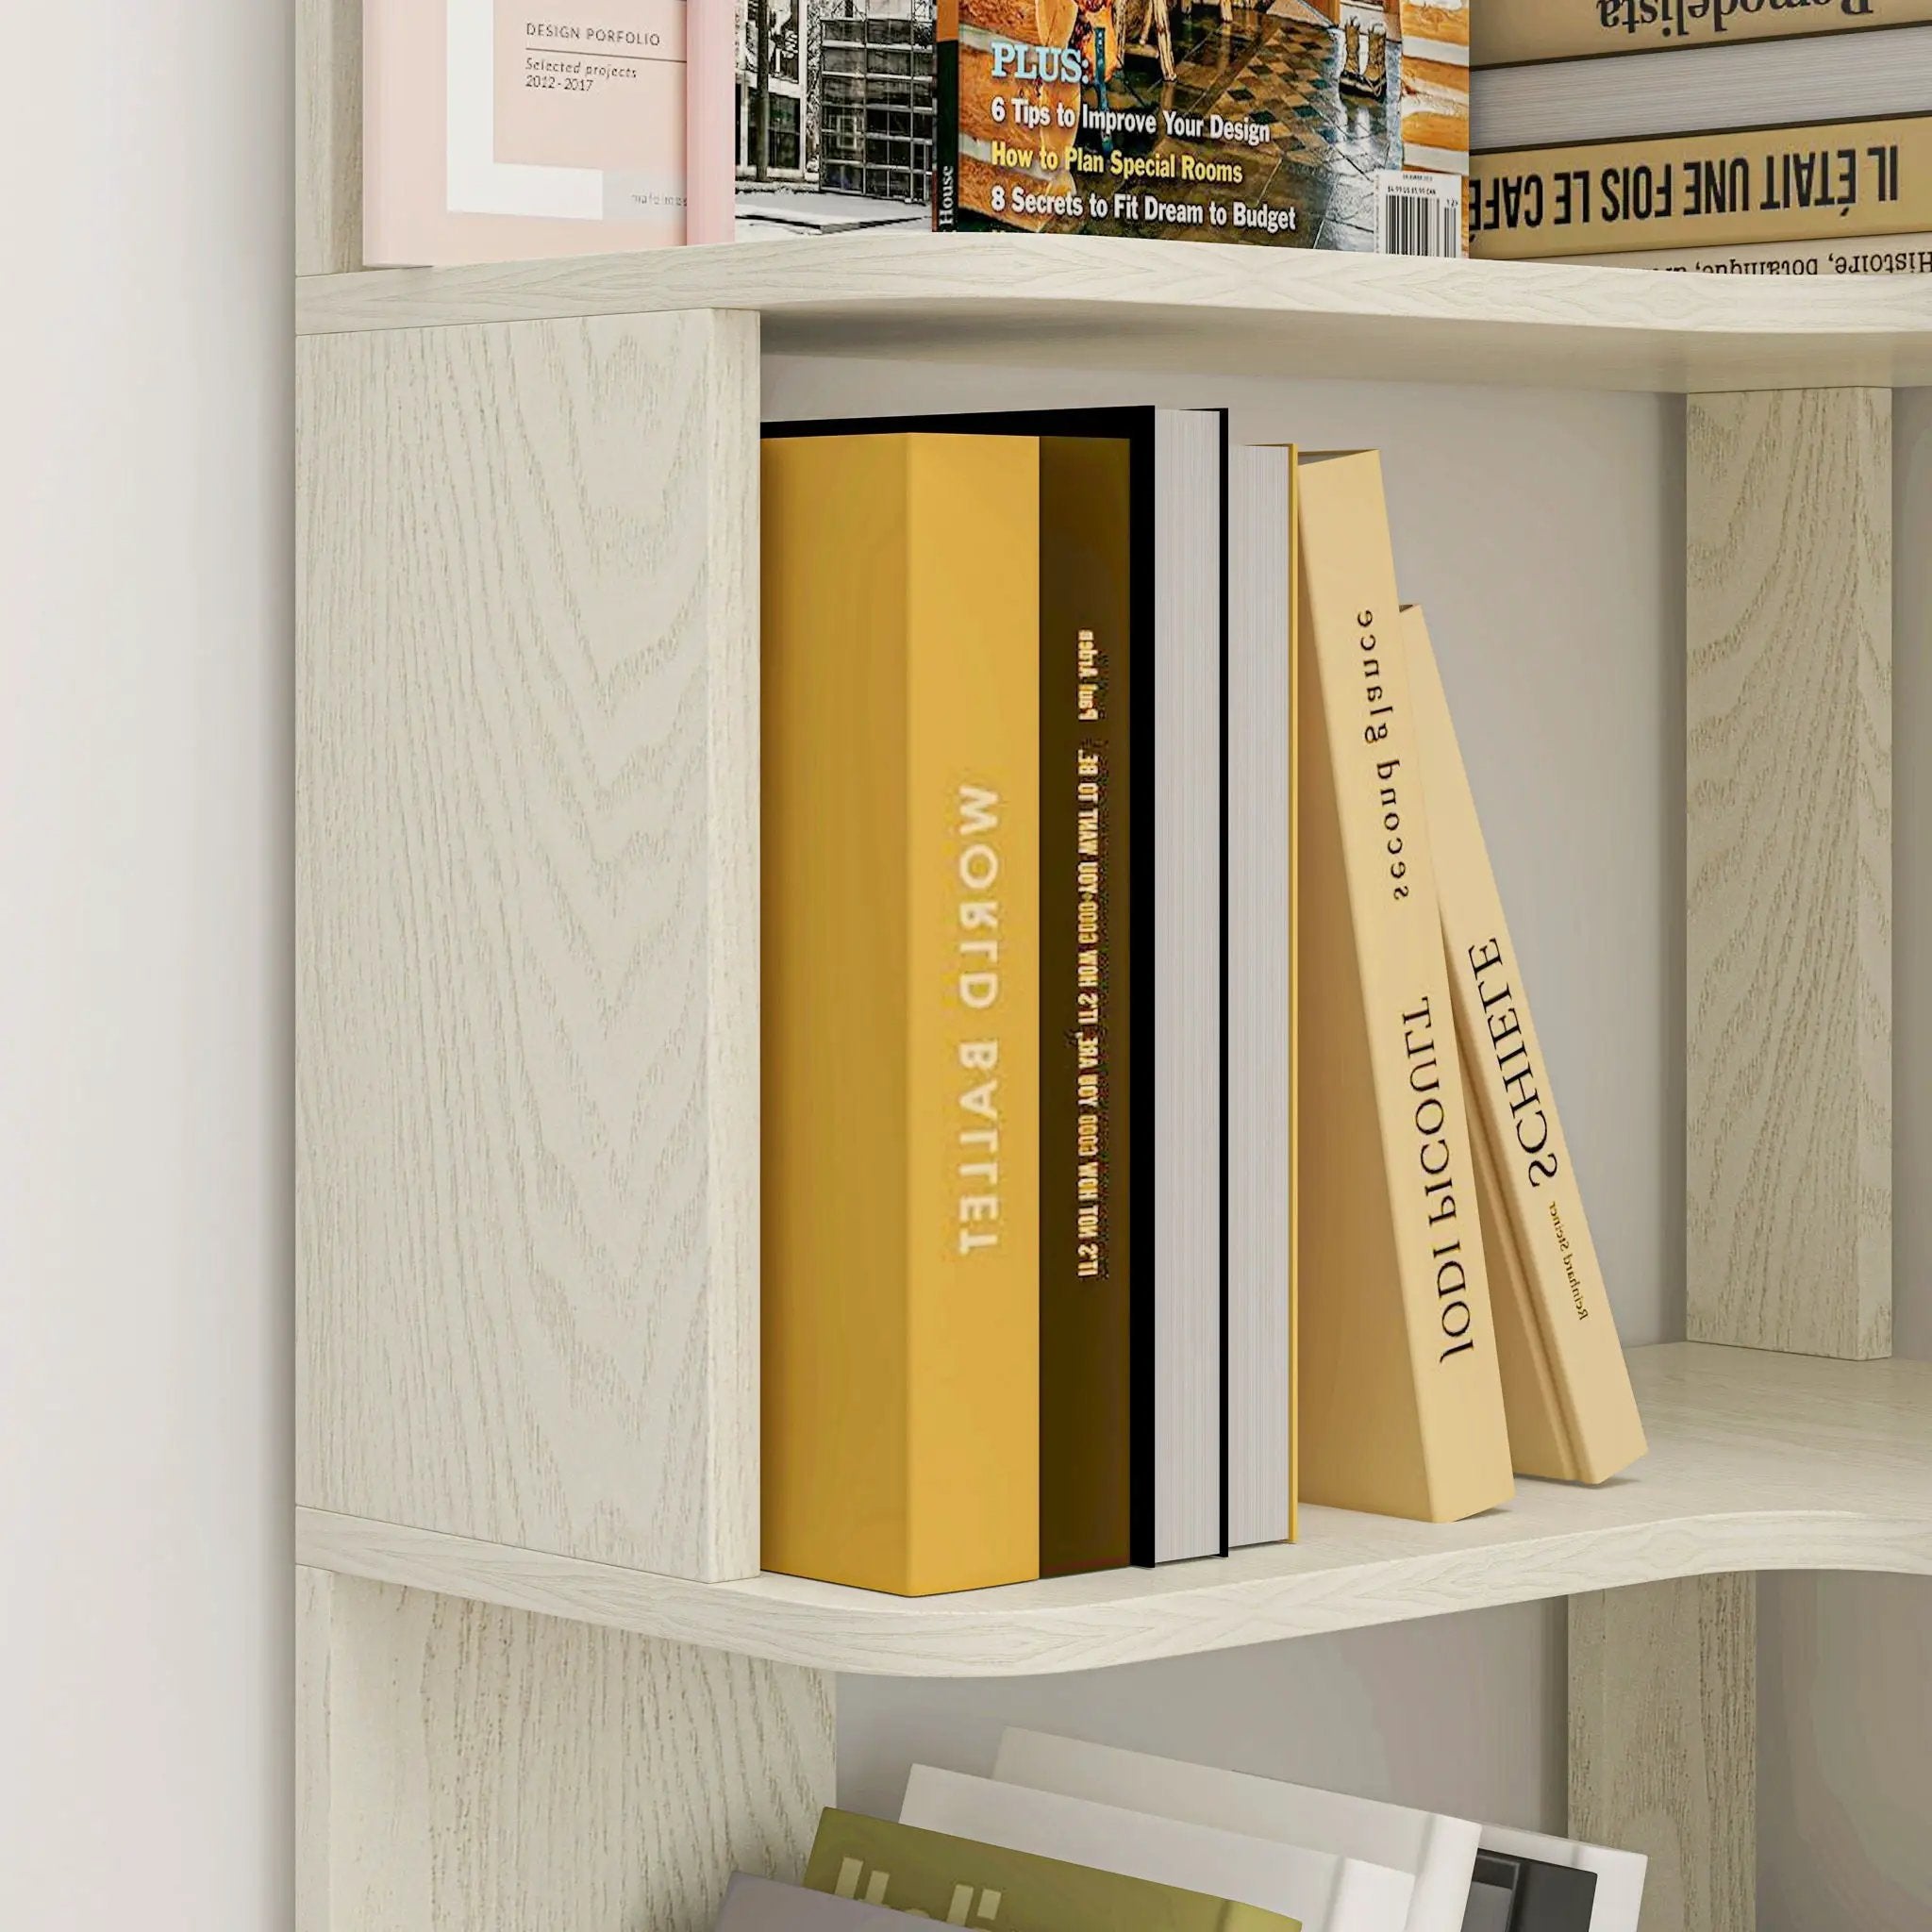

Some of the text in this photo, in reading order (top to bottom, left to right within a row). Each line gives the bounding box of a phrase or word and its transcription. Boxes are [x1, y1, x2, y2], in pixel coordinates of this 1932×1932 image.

[525, 22, 660, 46] DESIGN PORFOLIO
[1596, 0, 1874, 36] odelista
[525, 57, 637, 79] Selected projects
[991, 42, 1089, 84] PLUS:
[991, 96, 1271, 146] 6 Tips to Improve Your Design
[992, 141, 1243, 183] How to Plan Special Rooms
[939, 166, 954, 226] House
[991, 185, 1296, 233] 8 Secrets to Fit Dream to Budget
[1469, 145, 1898, 243] IL ÉTAIT UNE FOIS LE CAFÉ
[1827, 251, 1932, 275] Histoire,
